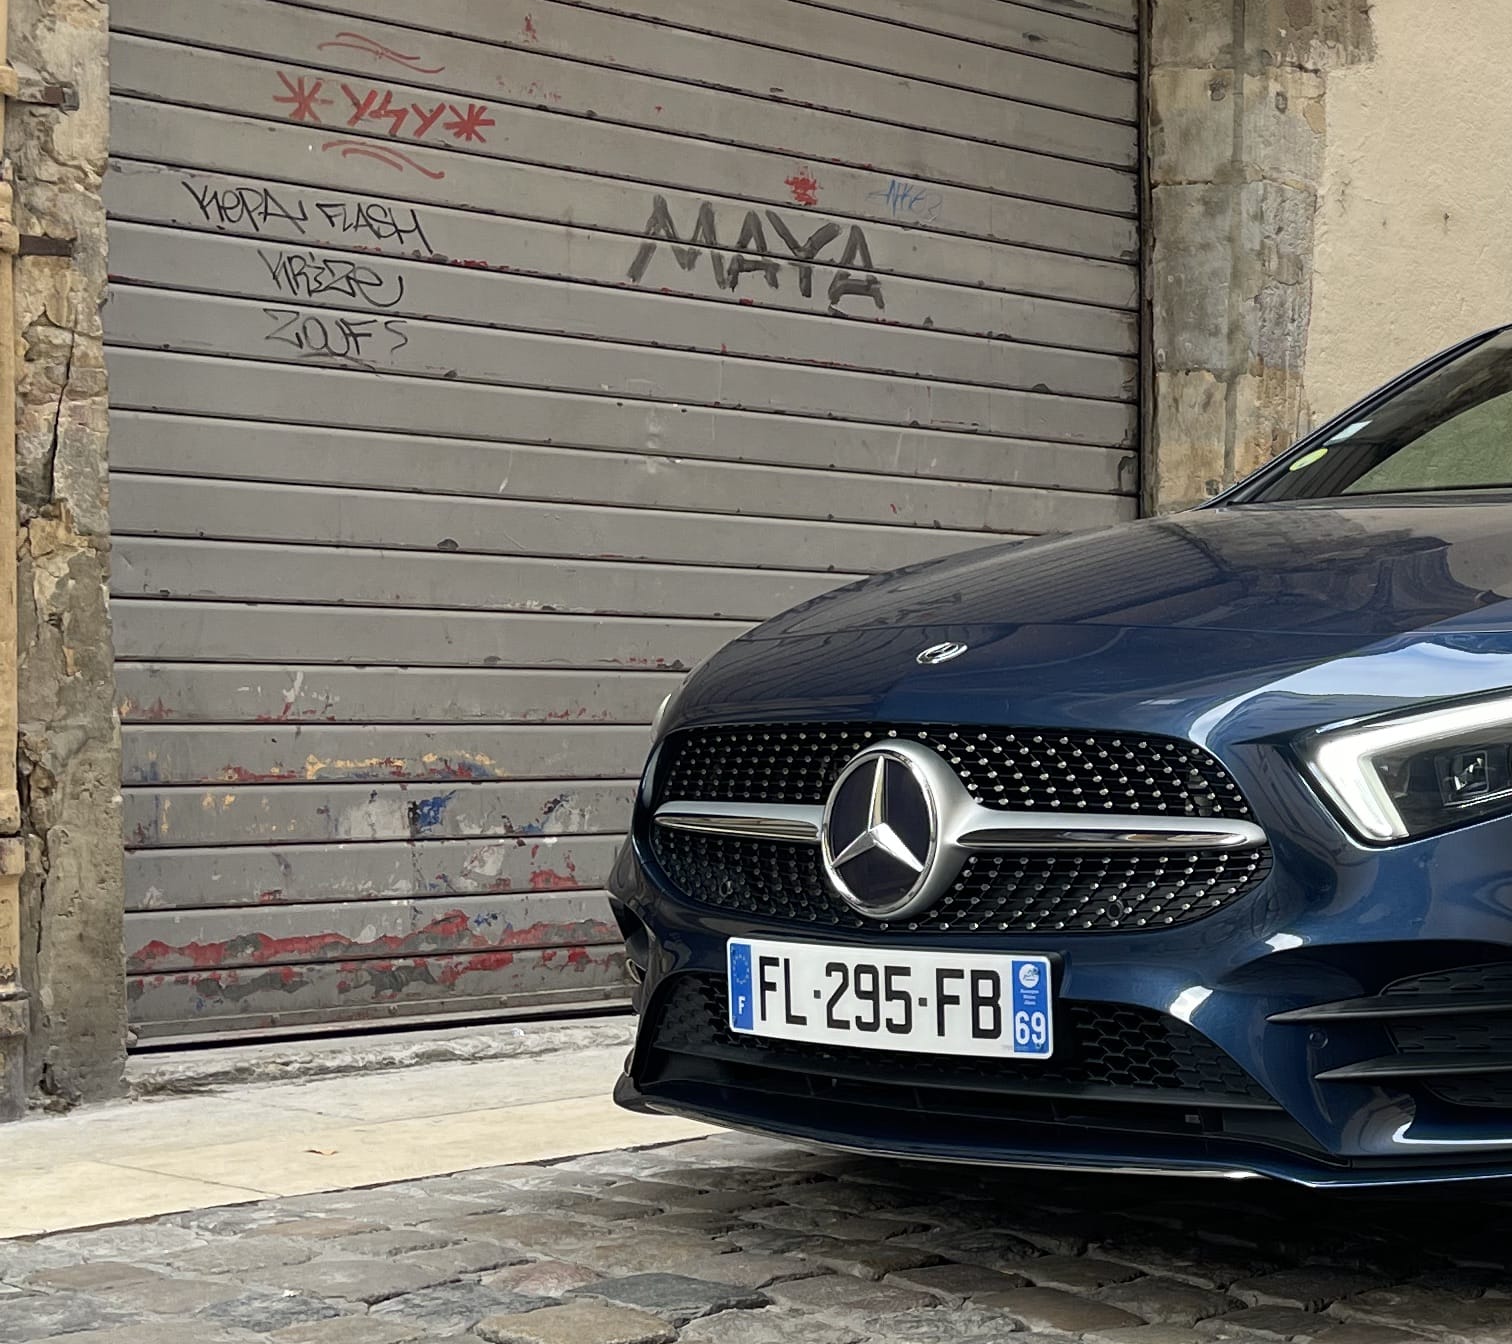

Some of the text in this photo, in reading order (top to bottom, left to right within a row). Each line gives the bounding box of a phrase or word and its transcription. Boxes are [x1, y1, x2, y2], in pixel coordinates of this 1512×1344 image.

[626, 193, 885, 310] MAYA
[738, 996, 746, 1015] F
[759, 955, 1002, 1040] FL-295-FB
[1015, 1010, 1047, 1046] 69
